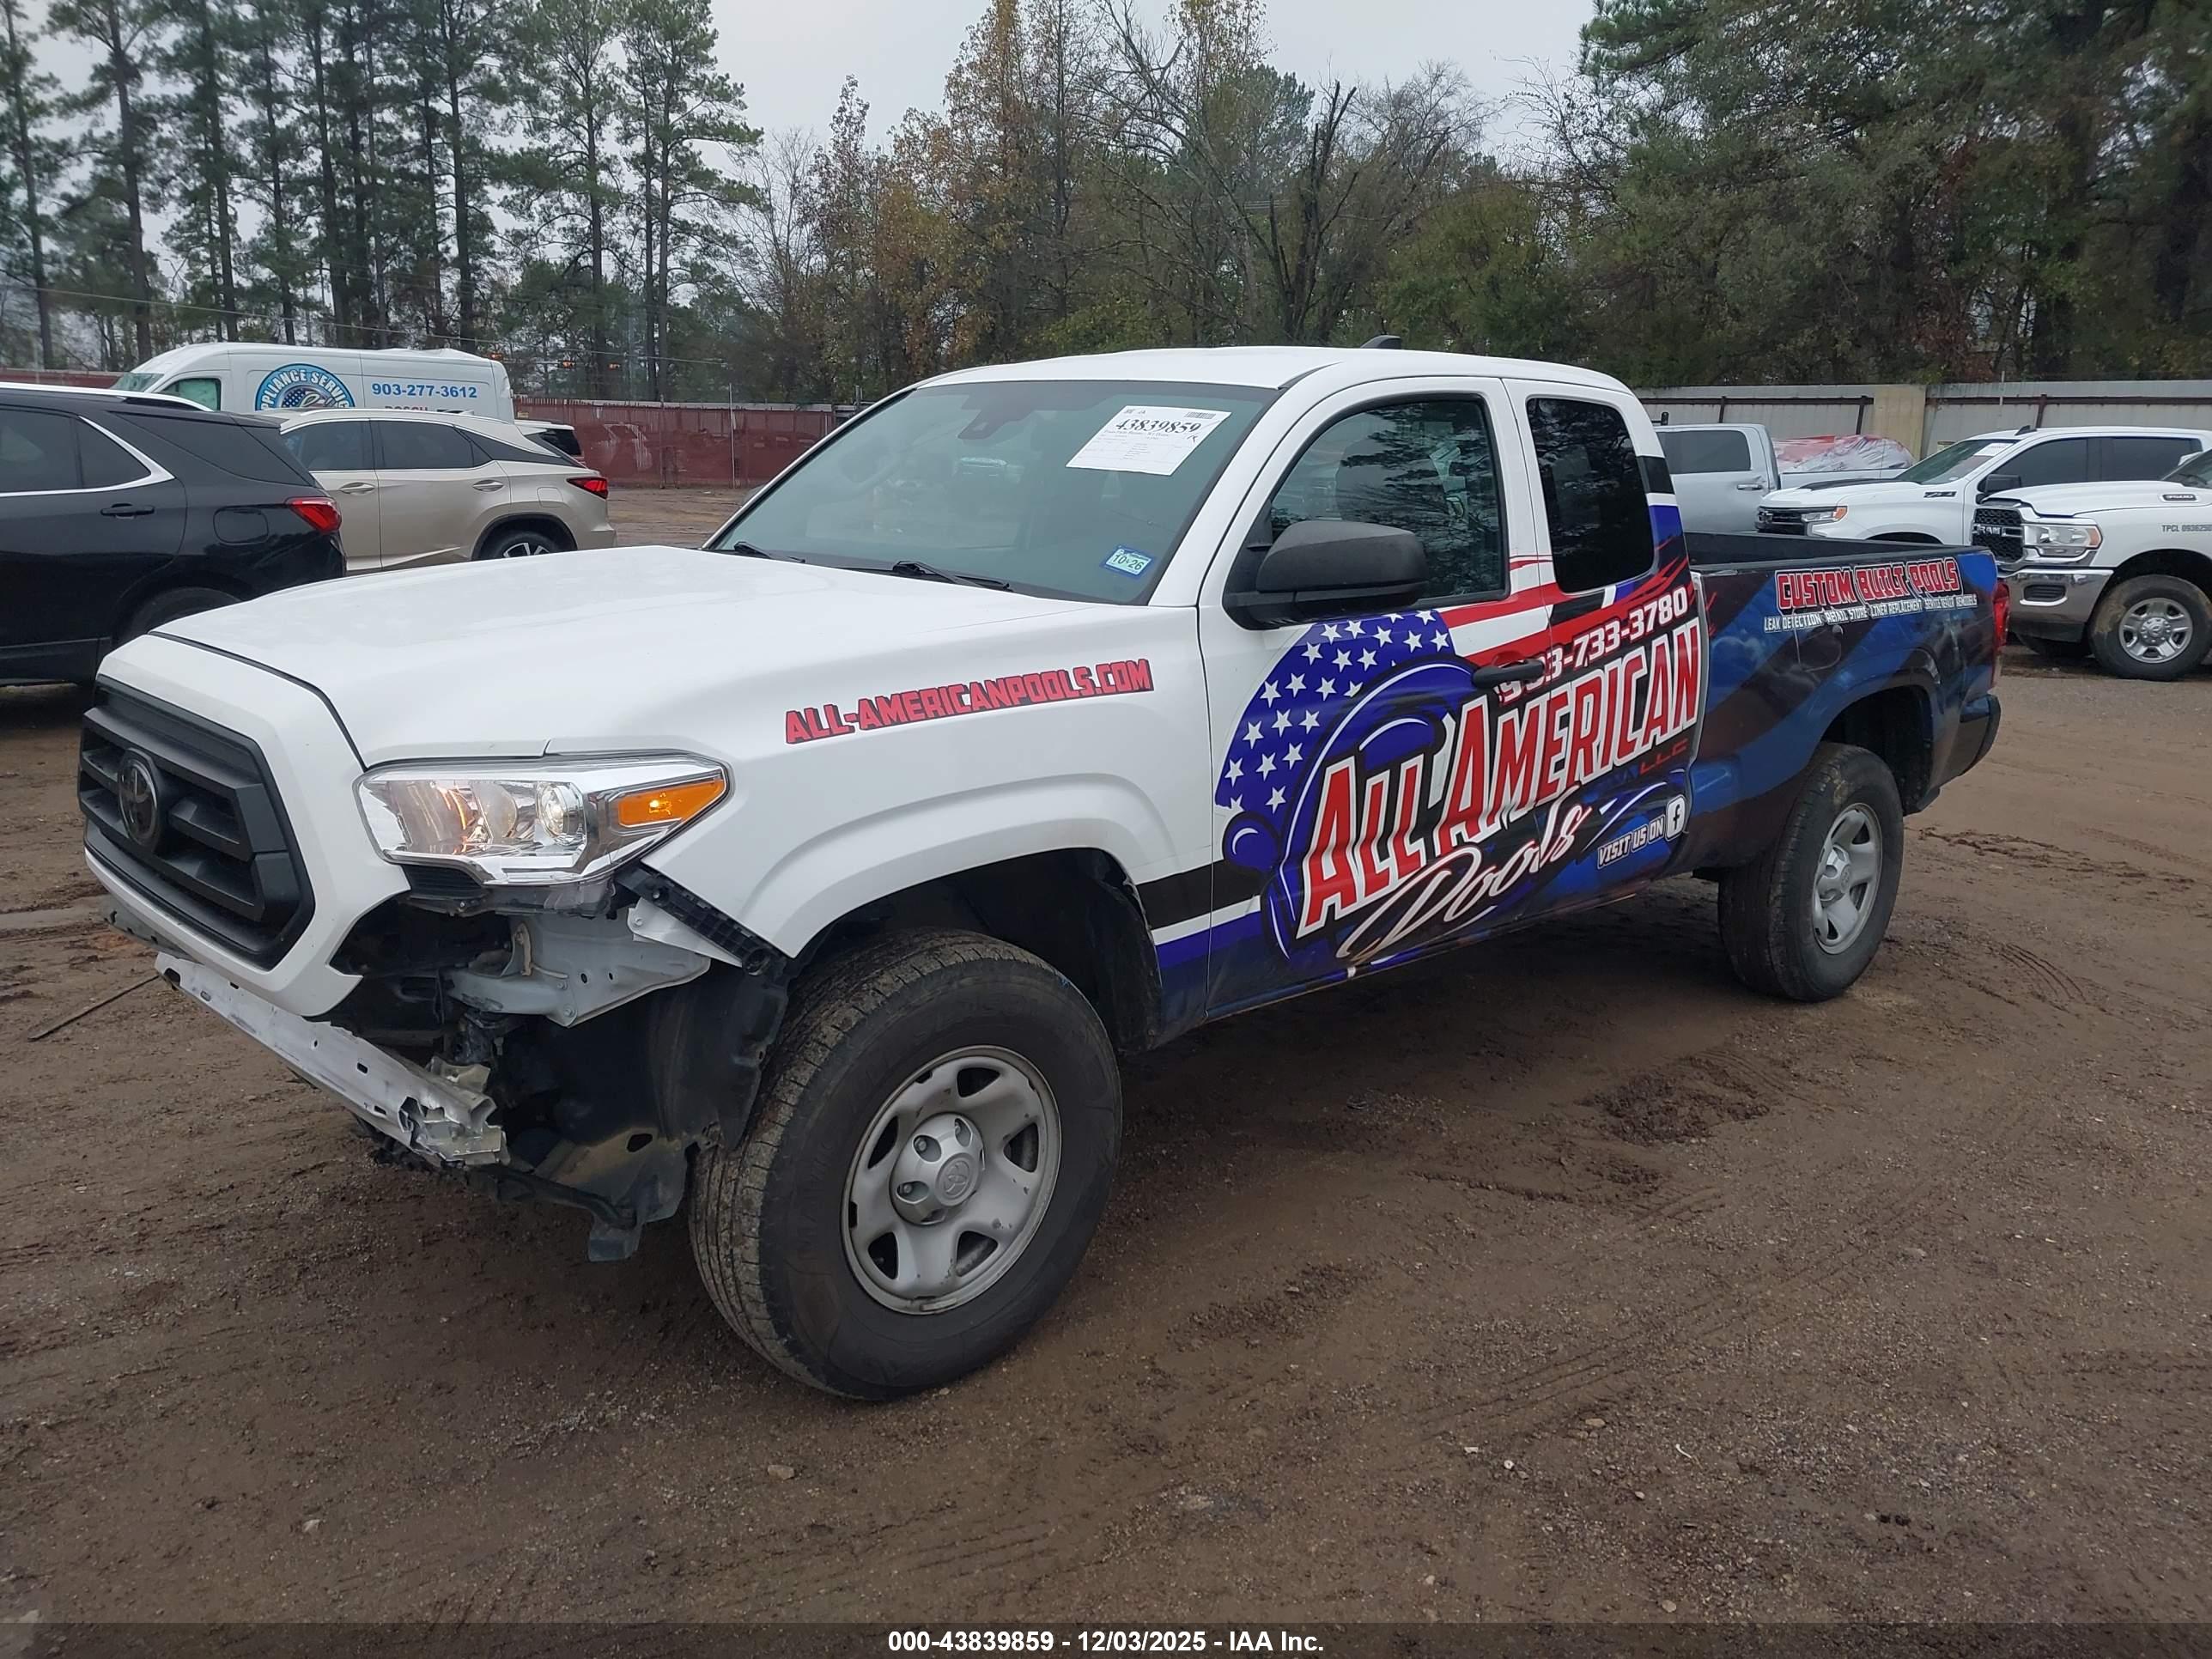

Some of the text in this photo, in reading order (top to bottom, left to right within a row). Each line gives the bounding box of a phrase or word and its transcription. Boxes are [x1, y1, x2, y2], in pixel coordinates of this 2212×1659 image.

[260, 368, 350, 410] PPLIANCE SERVIC
[372, 383, 477, 398] 903-277-3612
[1115, 418, 1202, 434] 43839859
[1980, 526, 2001, 534] RAM
[1112, 554, 1127, 564] 10
[1127, 559, 1145, 570] 26
[1778, 560, 1960, 610] CUSTOM BUILT POOLS
[1764, 617, 1781, 632] LEAK
[1782, 612, 1823, 630] DETECTION
[1824, 610, 1849, 623] RETAIL
[1871, 603, 1889, 617] LINER
[785, 658, 1155, 744] ALL-AMERICANPOOLS.COM
[1296, 617, 1701, 939] ALL AMERICAN
[1598, 836, 1632, 866] VISIT
[1632, 827, 1647, 850] US
[1649, 818, 1665, 842] ON
[1335, 784, 1593, 964] Pools
